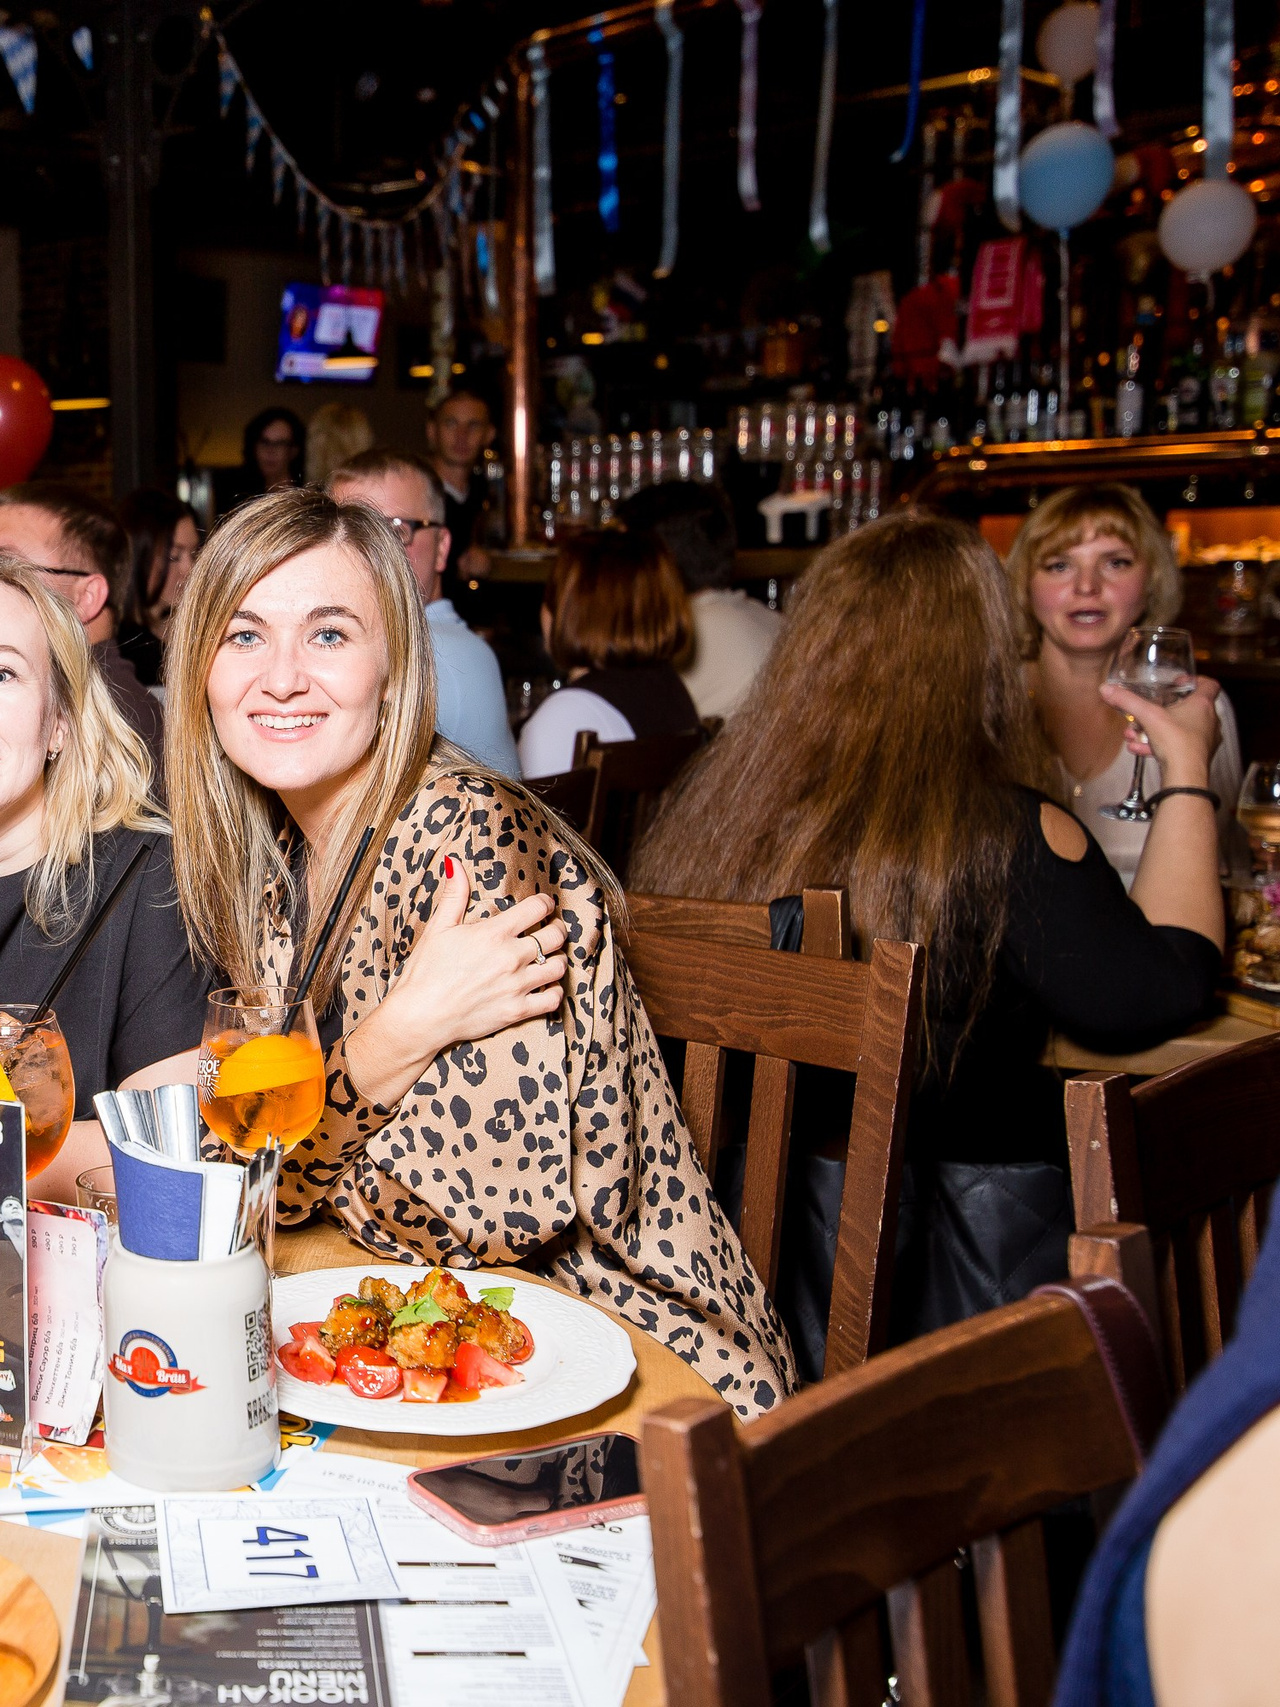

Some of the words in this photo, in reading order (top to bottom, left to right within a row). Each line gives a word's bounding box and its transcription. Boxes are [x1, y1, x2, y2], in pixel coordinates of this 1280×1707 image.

[31, 1374, 44, 1402] Виски
[38, 1345, 50, 1373] Сауэр
[64, 1352, 75, 1379] Тоник
[242, 1526, 319, 1578] 417
[217, 1683, 370, 1704] HOOKAH
[269, 1670, 366, 1690] MENU
